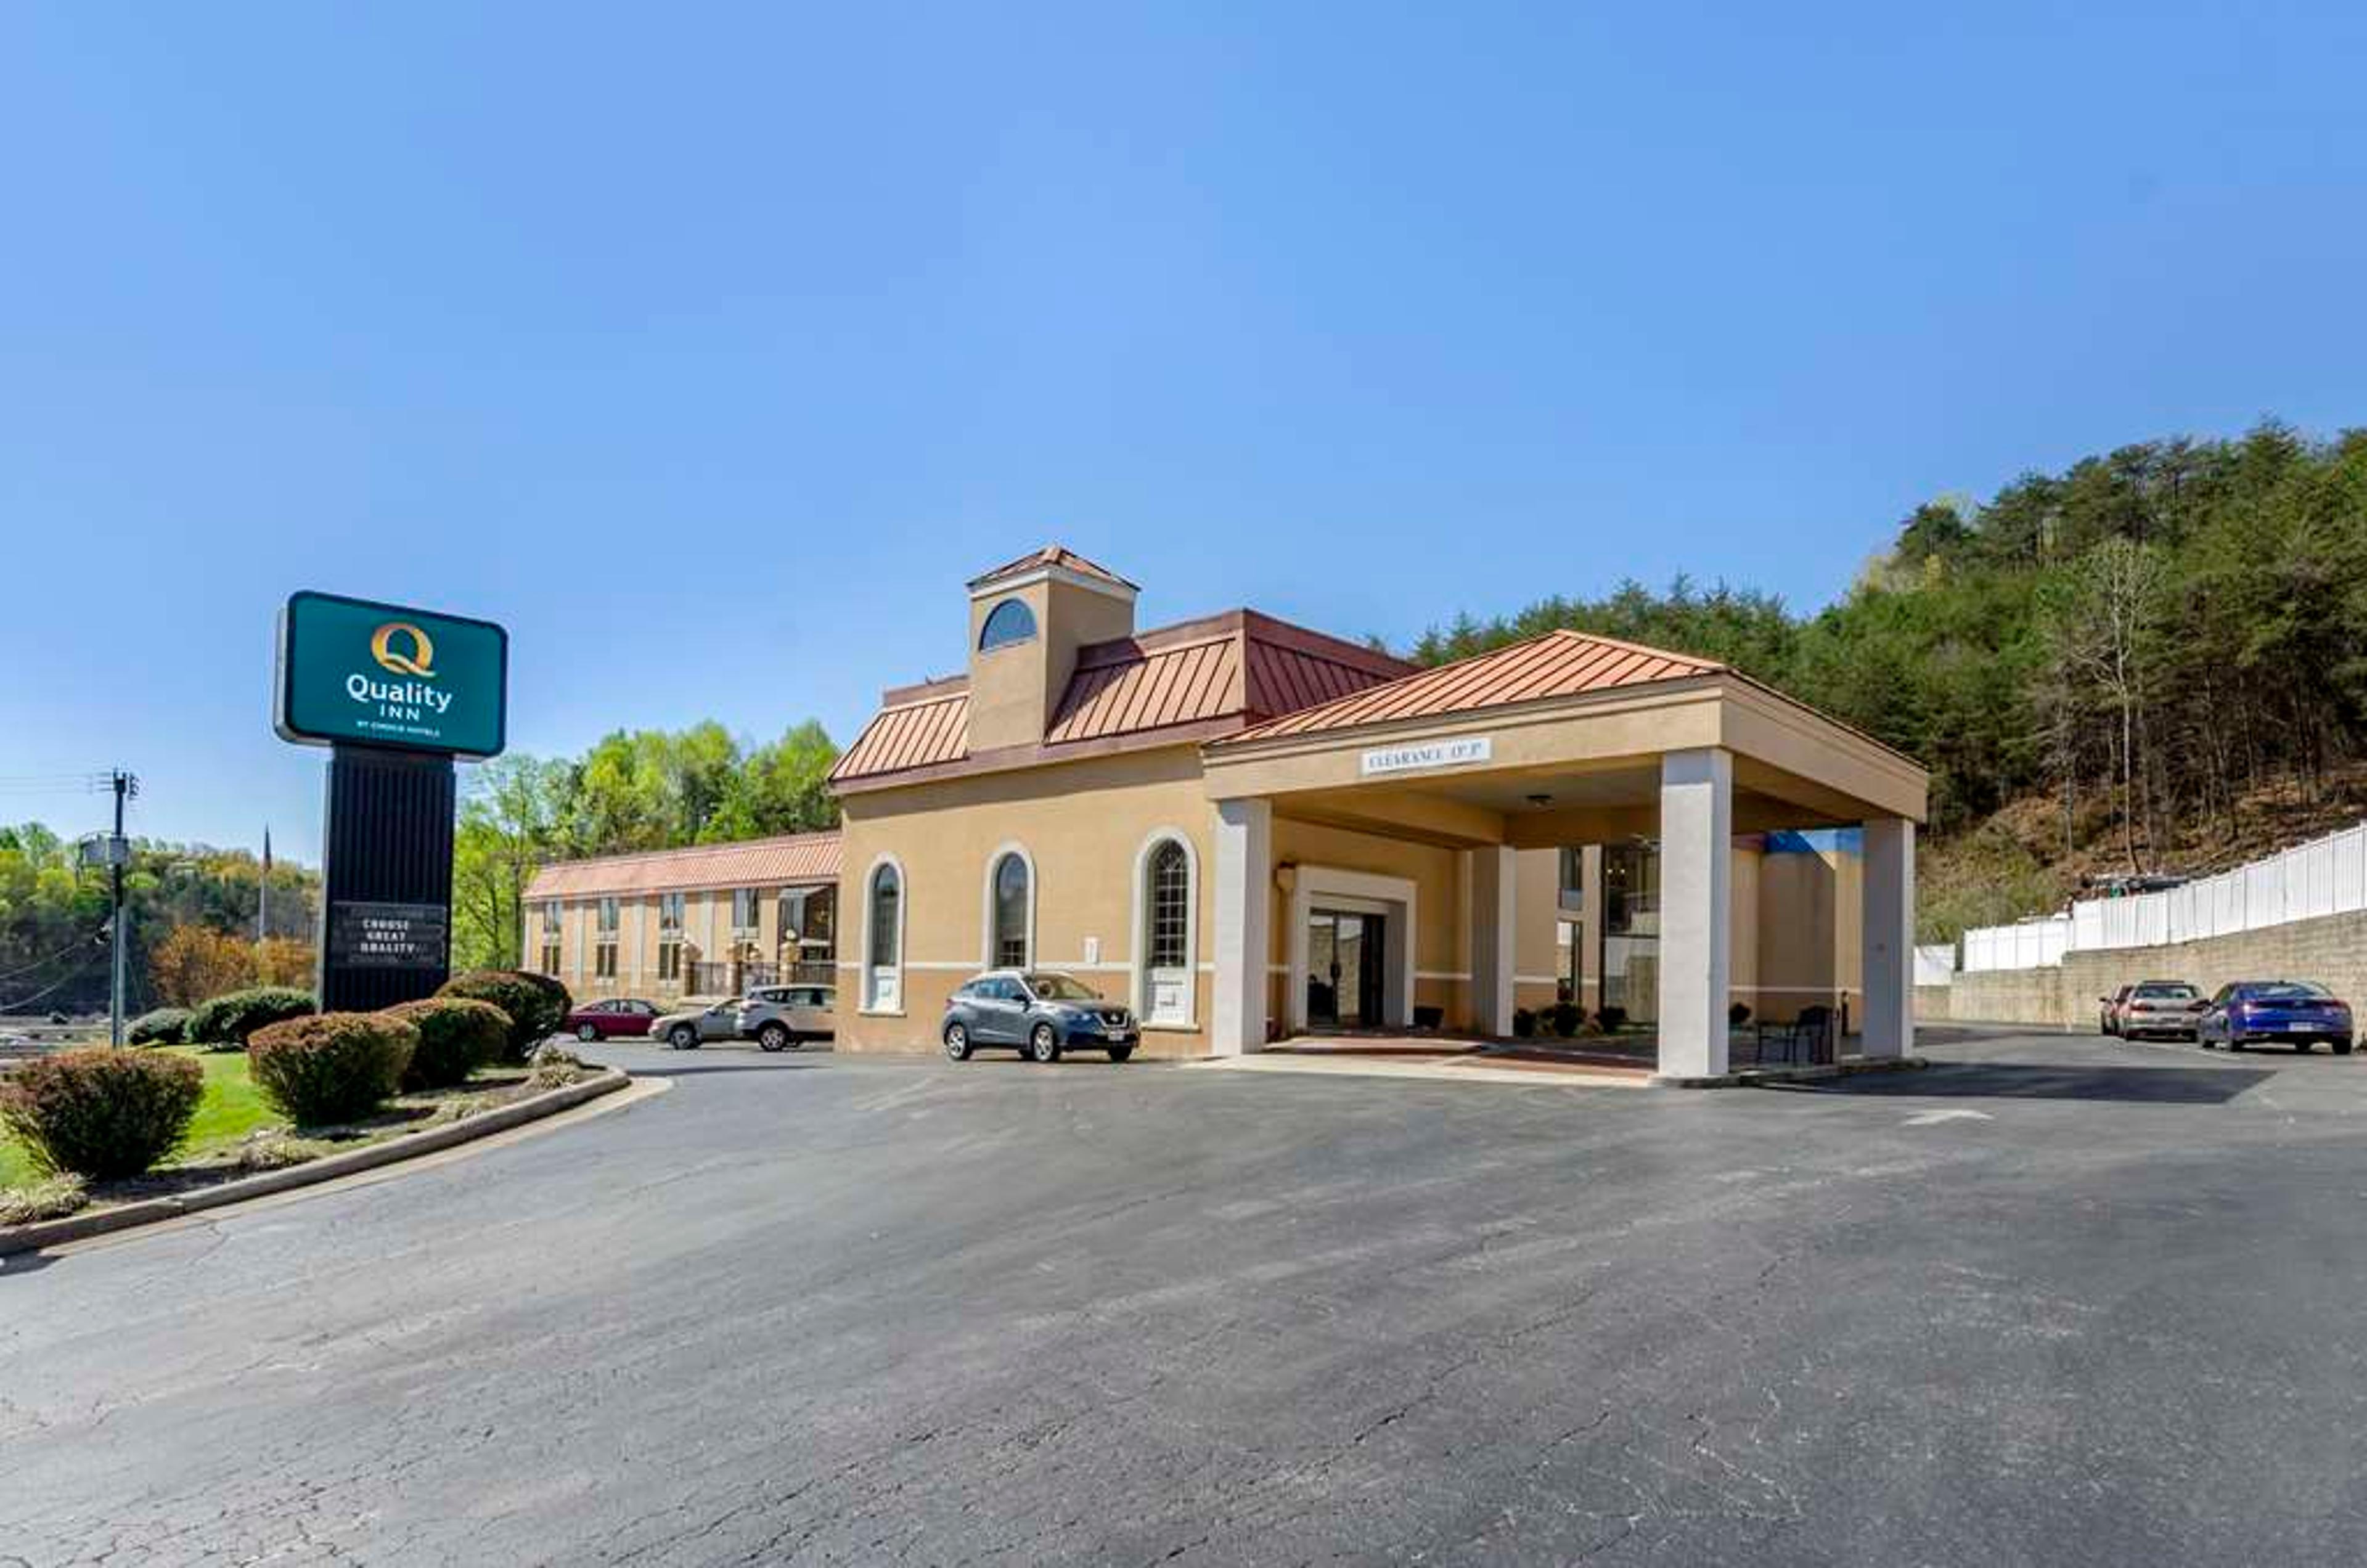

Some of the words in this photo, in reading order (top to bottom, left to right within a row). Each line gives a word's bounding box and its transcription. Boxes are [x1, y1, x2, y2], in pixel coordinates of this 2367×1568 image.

[347, 674, 452, 713] Quality
[380, 704, 420, 721] INN
[1369, 749, 1442, 768] CLEARANCE
[366, 931, 406, 942] GREAT
